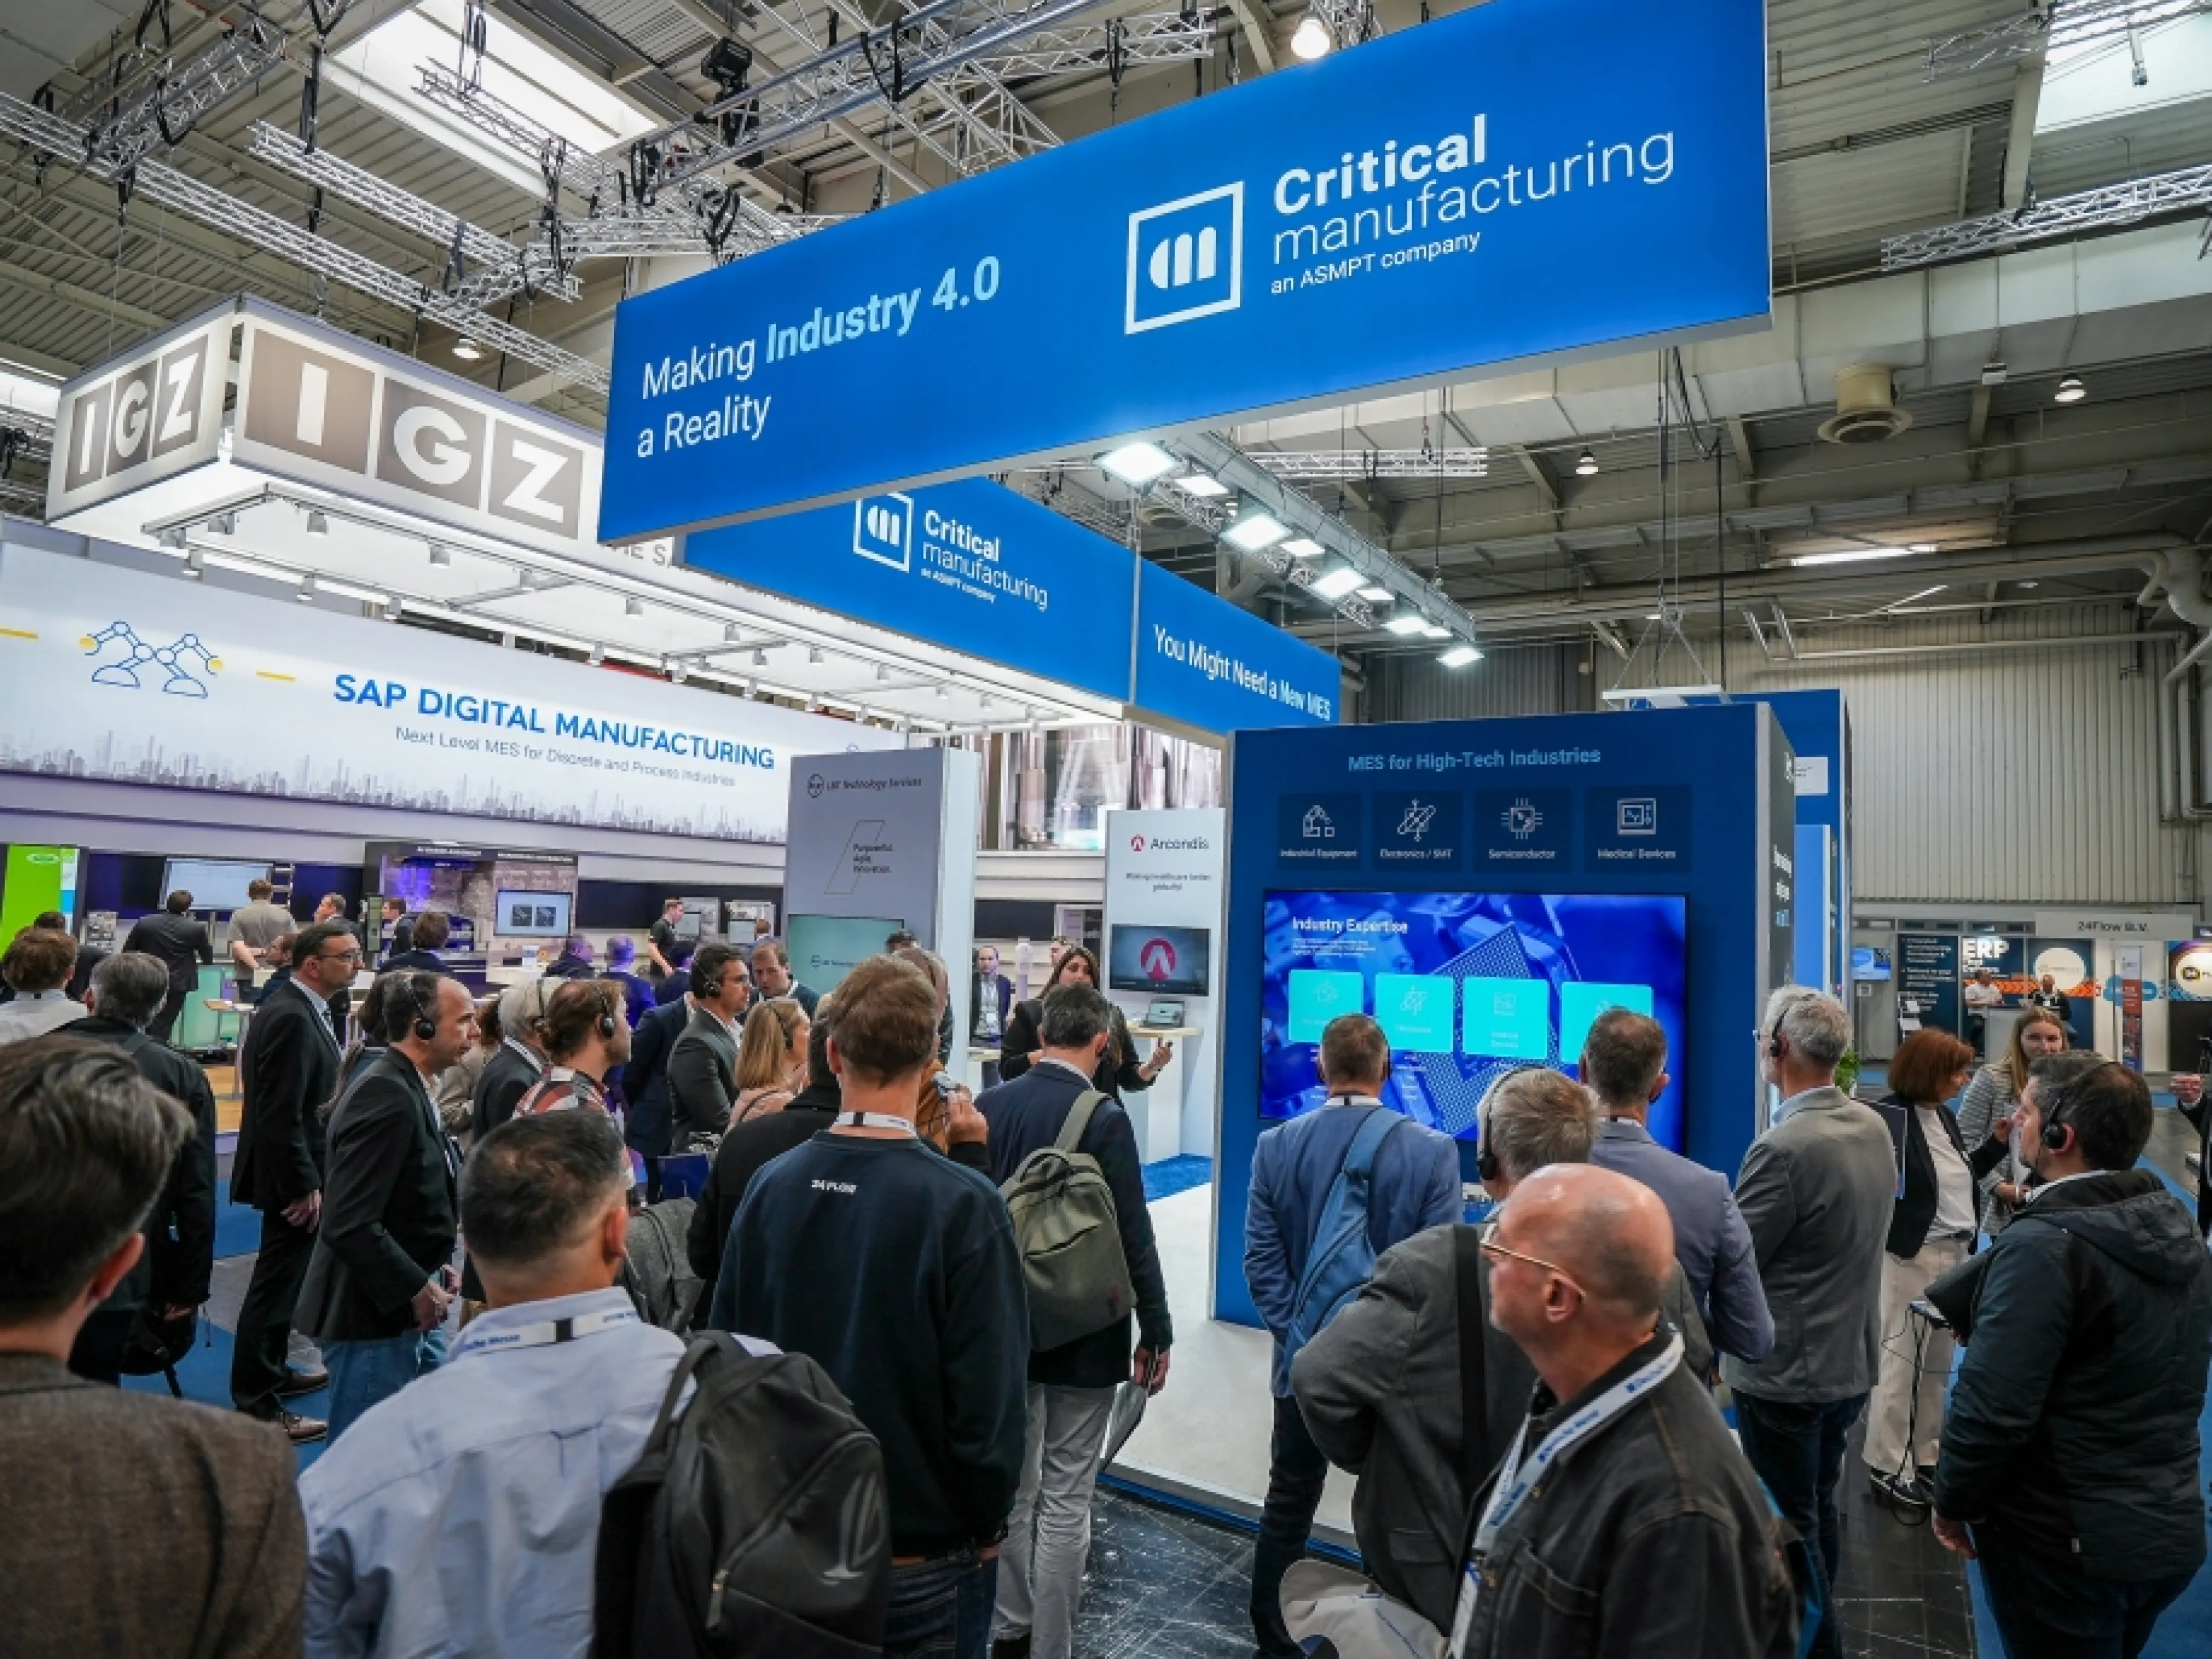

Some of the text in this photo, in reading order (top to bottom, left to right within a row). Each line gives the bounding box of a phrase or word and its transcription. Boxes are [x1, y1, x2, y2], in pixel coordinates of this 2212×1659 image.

[1274, 114, 1486, 214] Critical
[1272, 132, 1673, 264] manufacturing
[1271, 233, 1479, 294] an ASMPT company
[642, 256, 999, 399] Making Industry 4.0
[81, 358, 199, 475] IGZ
[297, 363, 569, 523] IGZ
[638, 395, 771, 457] a Reality
[925, 510, 1000, 562] Critical
[922, 541, 1047, 612] manufacturing
[1153, 624, 1331, 721] You Might Need a New MES
[335, 673, 774, 768] SAP DIGITAL MANUFACTURING
[396, 726, 735, 787] Next Level MES for Discrete and Process Industries
[1348, 747, 1601, 771] MES for High-Tech Industries
[1150, 836, 1209, 850] Arcondis
[1489, 849, 1555, 859] Semiconductor
[1293, 917, 1408, 935] Industry Expertise
[1963, 937, 2009, 959] ERP
[2078, 921, 2120, 931] 24Flow
